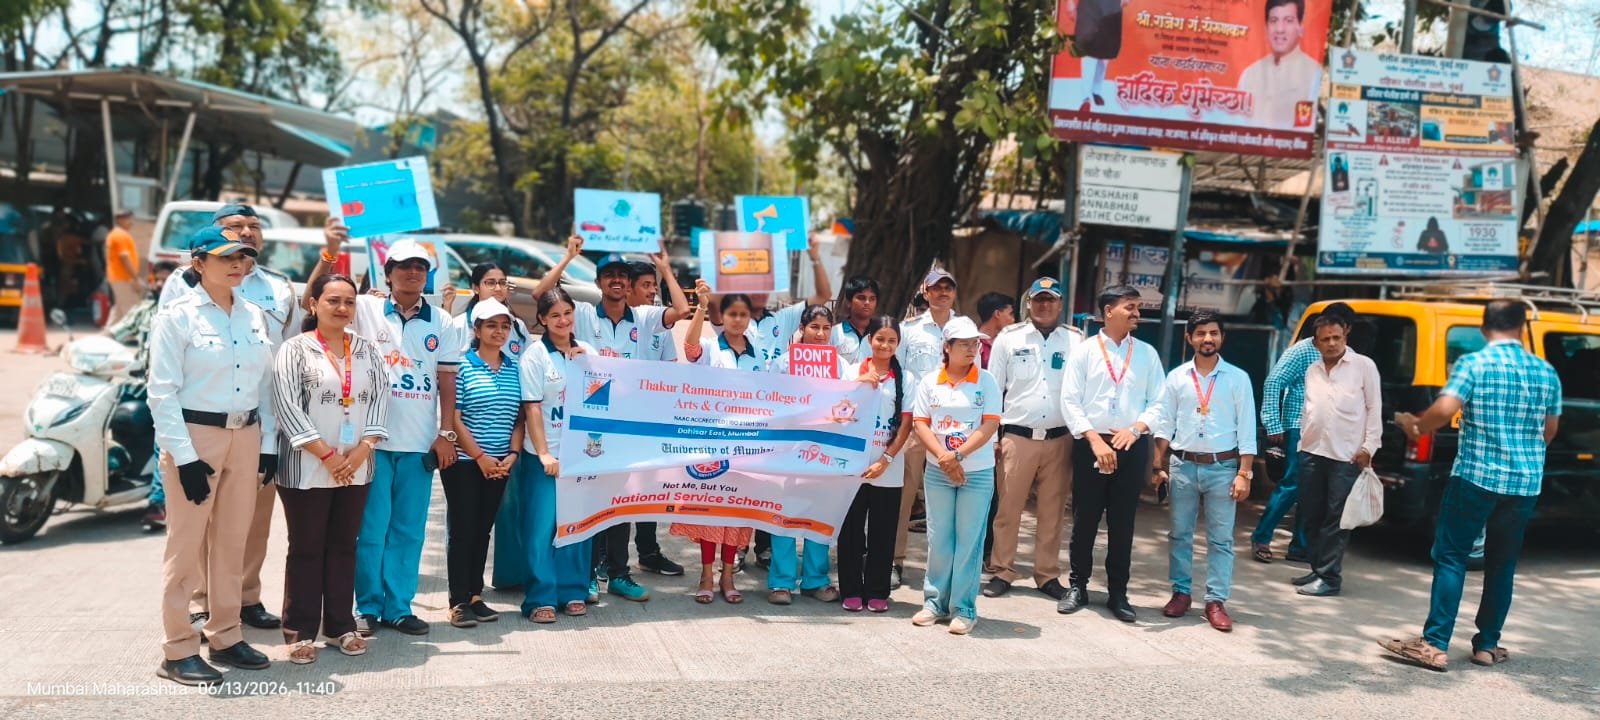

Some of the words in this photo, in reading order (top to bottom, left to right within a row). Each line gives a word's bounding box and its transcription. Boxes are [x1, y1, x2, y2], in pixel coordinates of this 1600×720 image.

[1117, 74, 1176, 106] हार्दिक
[1181, 81, 1253, 116] शुभेच्छा!
[1388, 136, 1412, 146] ALERT
[1081, 188, 1140, 200] LOKSHAHIR
[1081, 200, 1138, 212] ANNABHAU
[1080, 210, 1112, 220] SATHE
[1114, 212, 1152, 224] CHOWK
[1470, 228, 1496, 238] 1930
[794, 348, 832, 362] DON'T
[794, 364, 832, 378] HONK
[392, 374, 432, 392] .S.S
[639, 379, 678, 393] Thakur
[682, 383, 752, 400] Ramnarayan
[756, 388, 796, 404] College
[800, 394, 812, 405] of
[674, 398, 698, 410] Arts
[701, 401, 710, 412] &
[714, 402, 774, 416] Commerce
[678, 428, 707, 436] Dahisar
[662, 442, 716, 454] University
[720, 446, 730, 455] of
[682, 482, 698, 491] Me,
[700, 483, 717, 491] But
[720, 484, 738, 493] You
[612, 492, 670, 506] National
[674, 492, 722, 504] Service
[727, 494, 783, 511] Scheme
